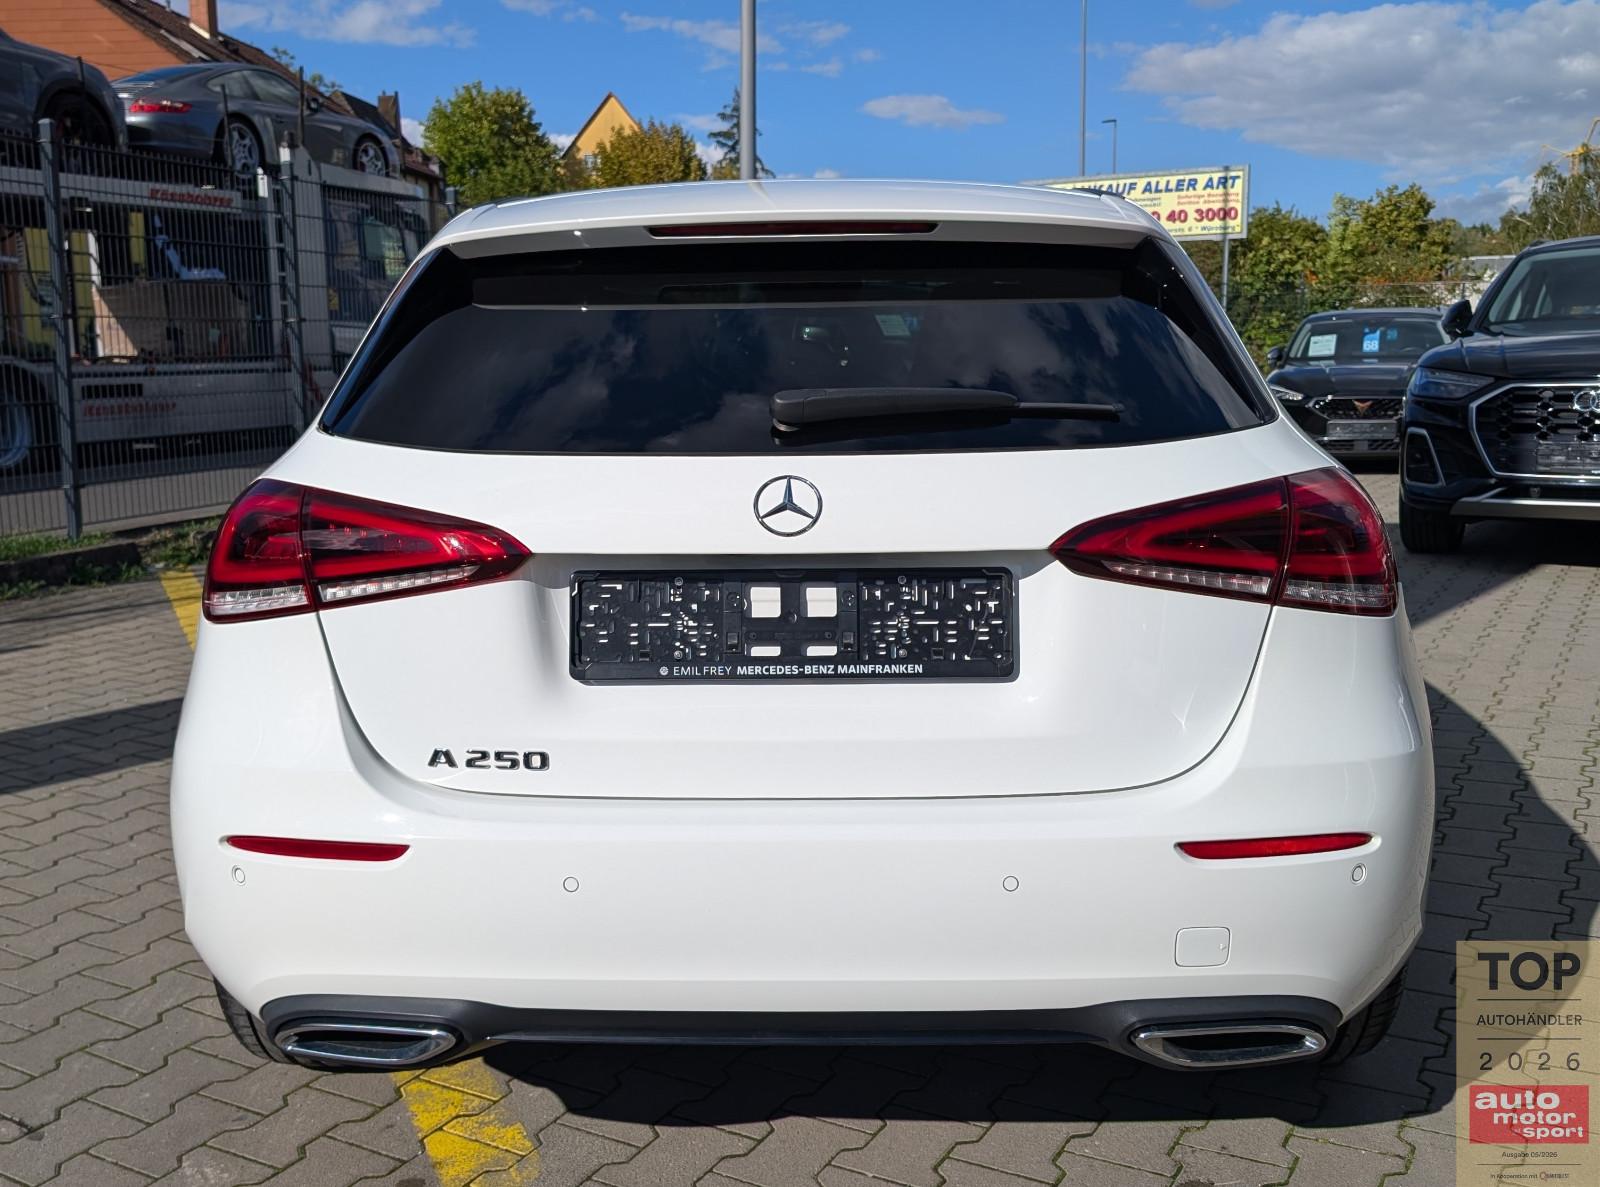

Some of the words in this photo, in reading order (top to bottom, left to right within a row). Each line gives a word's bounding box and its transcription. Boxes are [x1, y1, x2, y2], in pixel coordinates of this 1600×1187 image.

[1142, 179, 1198, 195] ALLER
[1203, 175, 1240, 191] ART
[1166, 209, 1188, 224] 40
[1194, 206, 1239, 223] 3000
[673, 667, 701, 676] EMIL
[704, 666, 732, 676] FREY
[737, 665, 835, 675] MERCEDES-BENZ
[838, 664, 923, 674] MAINFRANKEN
[427, 748, 459, 768] A
[465, 750, 550, 771] 250
